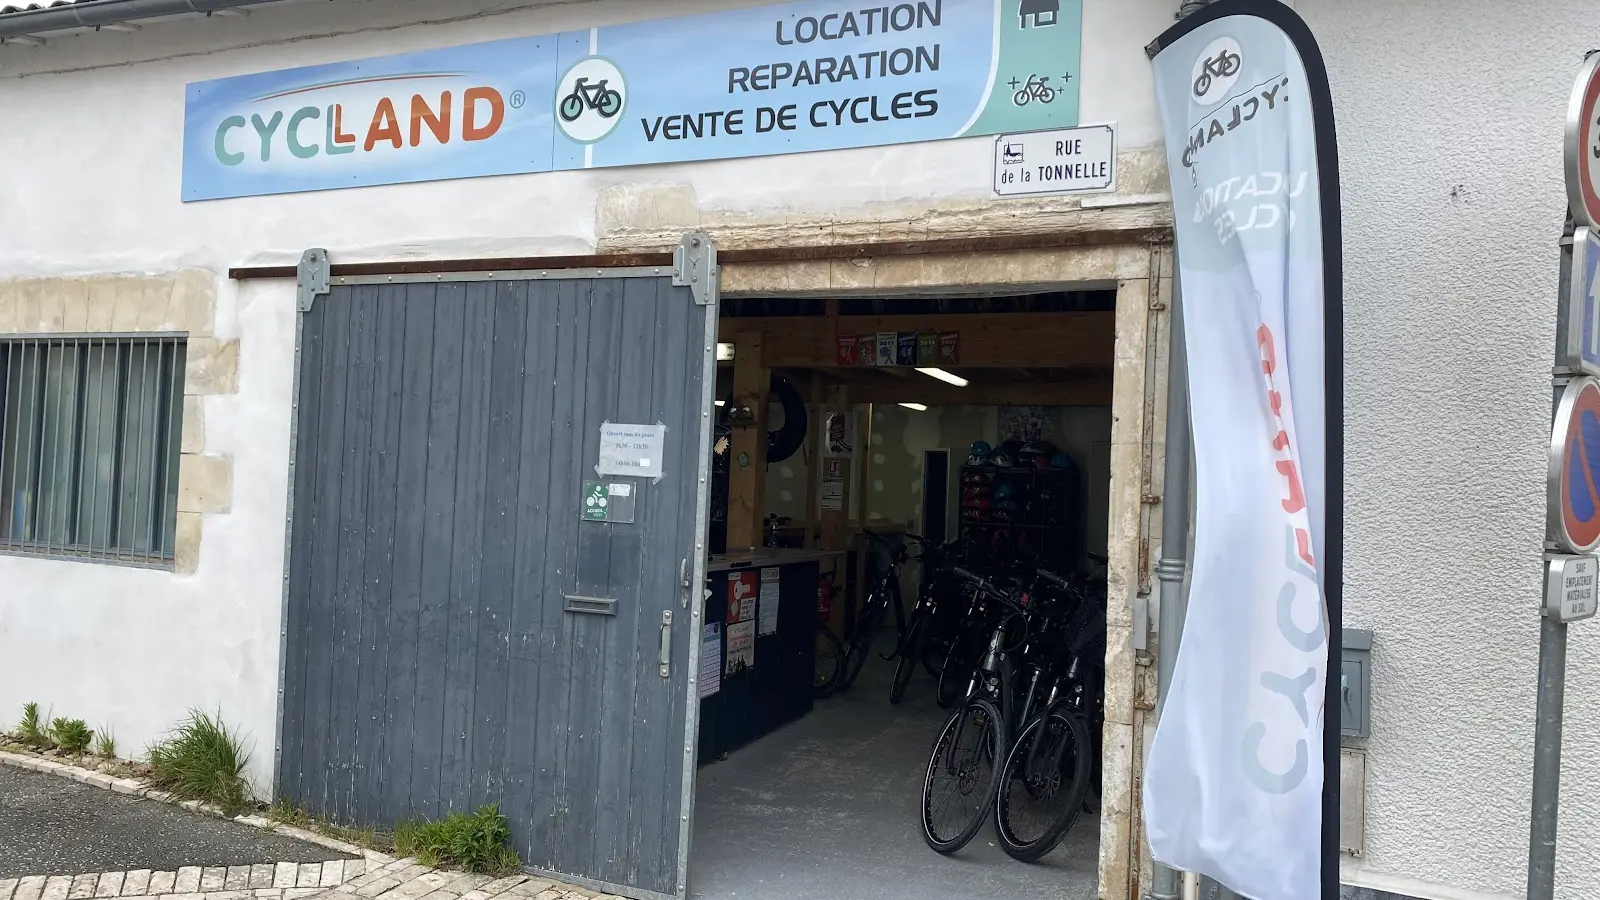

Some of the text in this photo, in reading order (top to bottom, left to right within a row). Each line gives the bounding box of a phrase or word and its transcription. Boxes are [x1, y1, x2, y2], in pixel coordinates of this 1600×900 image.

[775, 0, 942, 46] LOCATION
[728, 44, 940, 94] REPARATION
[640, 89, 939, 142] VENTE DE CYCLES
[1055, 139, 1082, 156] RUE
[1001, 161, 1107, 184] de la TONNELLE
[1566, 575, 1593, 588] EMPLACEMENT
